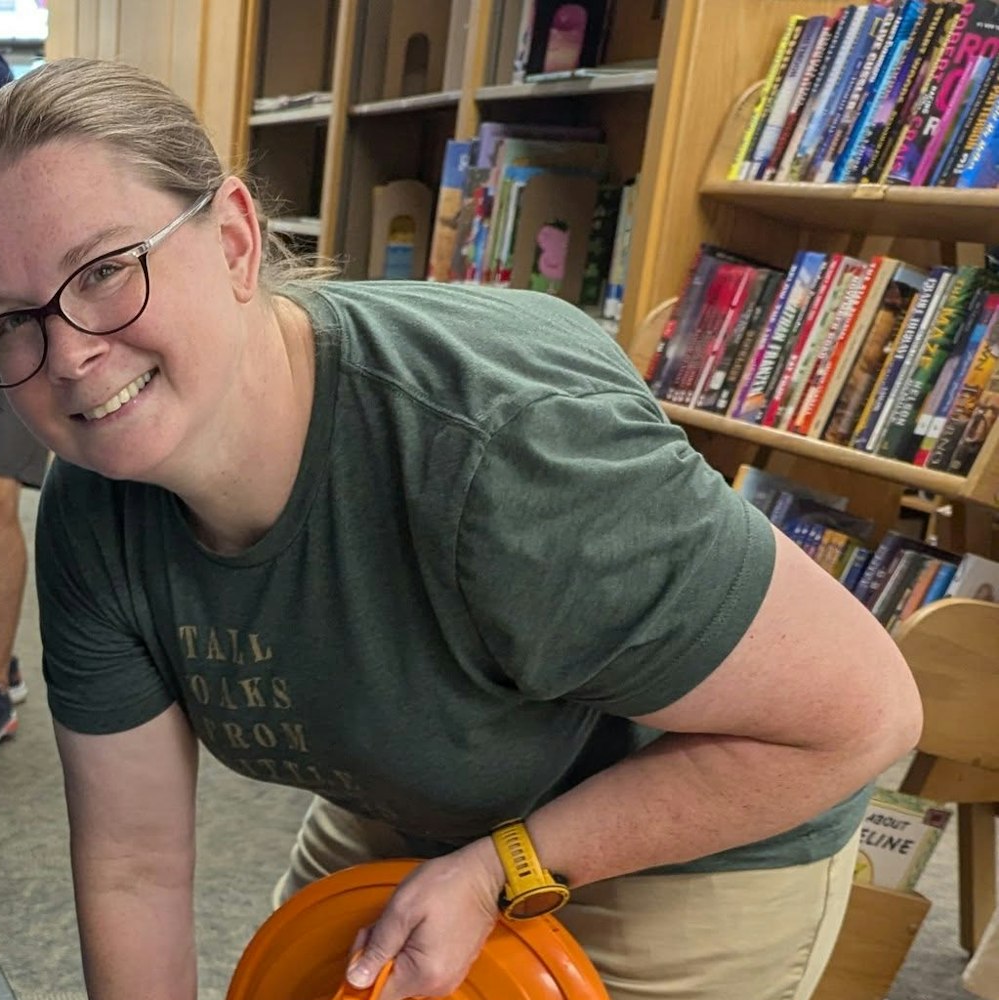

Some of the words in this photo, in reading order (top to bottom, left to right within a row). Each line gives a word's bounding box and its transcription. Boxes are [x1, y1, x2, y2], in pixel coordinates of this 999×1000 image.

[933, 3, 976, 83] ROBERT
[919, 306, 956, 371] MAZE
[897, 380, 924, 427] NELSON
[179, 625, 273, 665] TALL
[189, 674, 293, 710] OAKS
[203, 717, 309, 753] FROM
[866, 813, 911, 831] ABOUT
